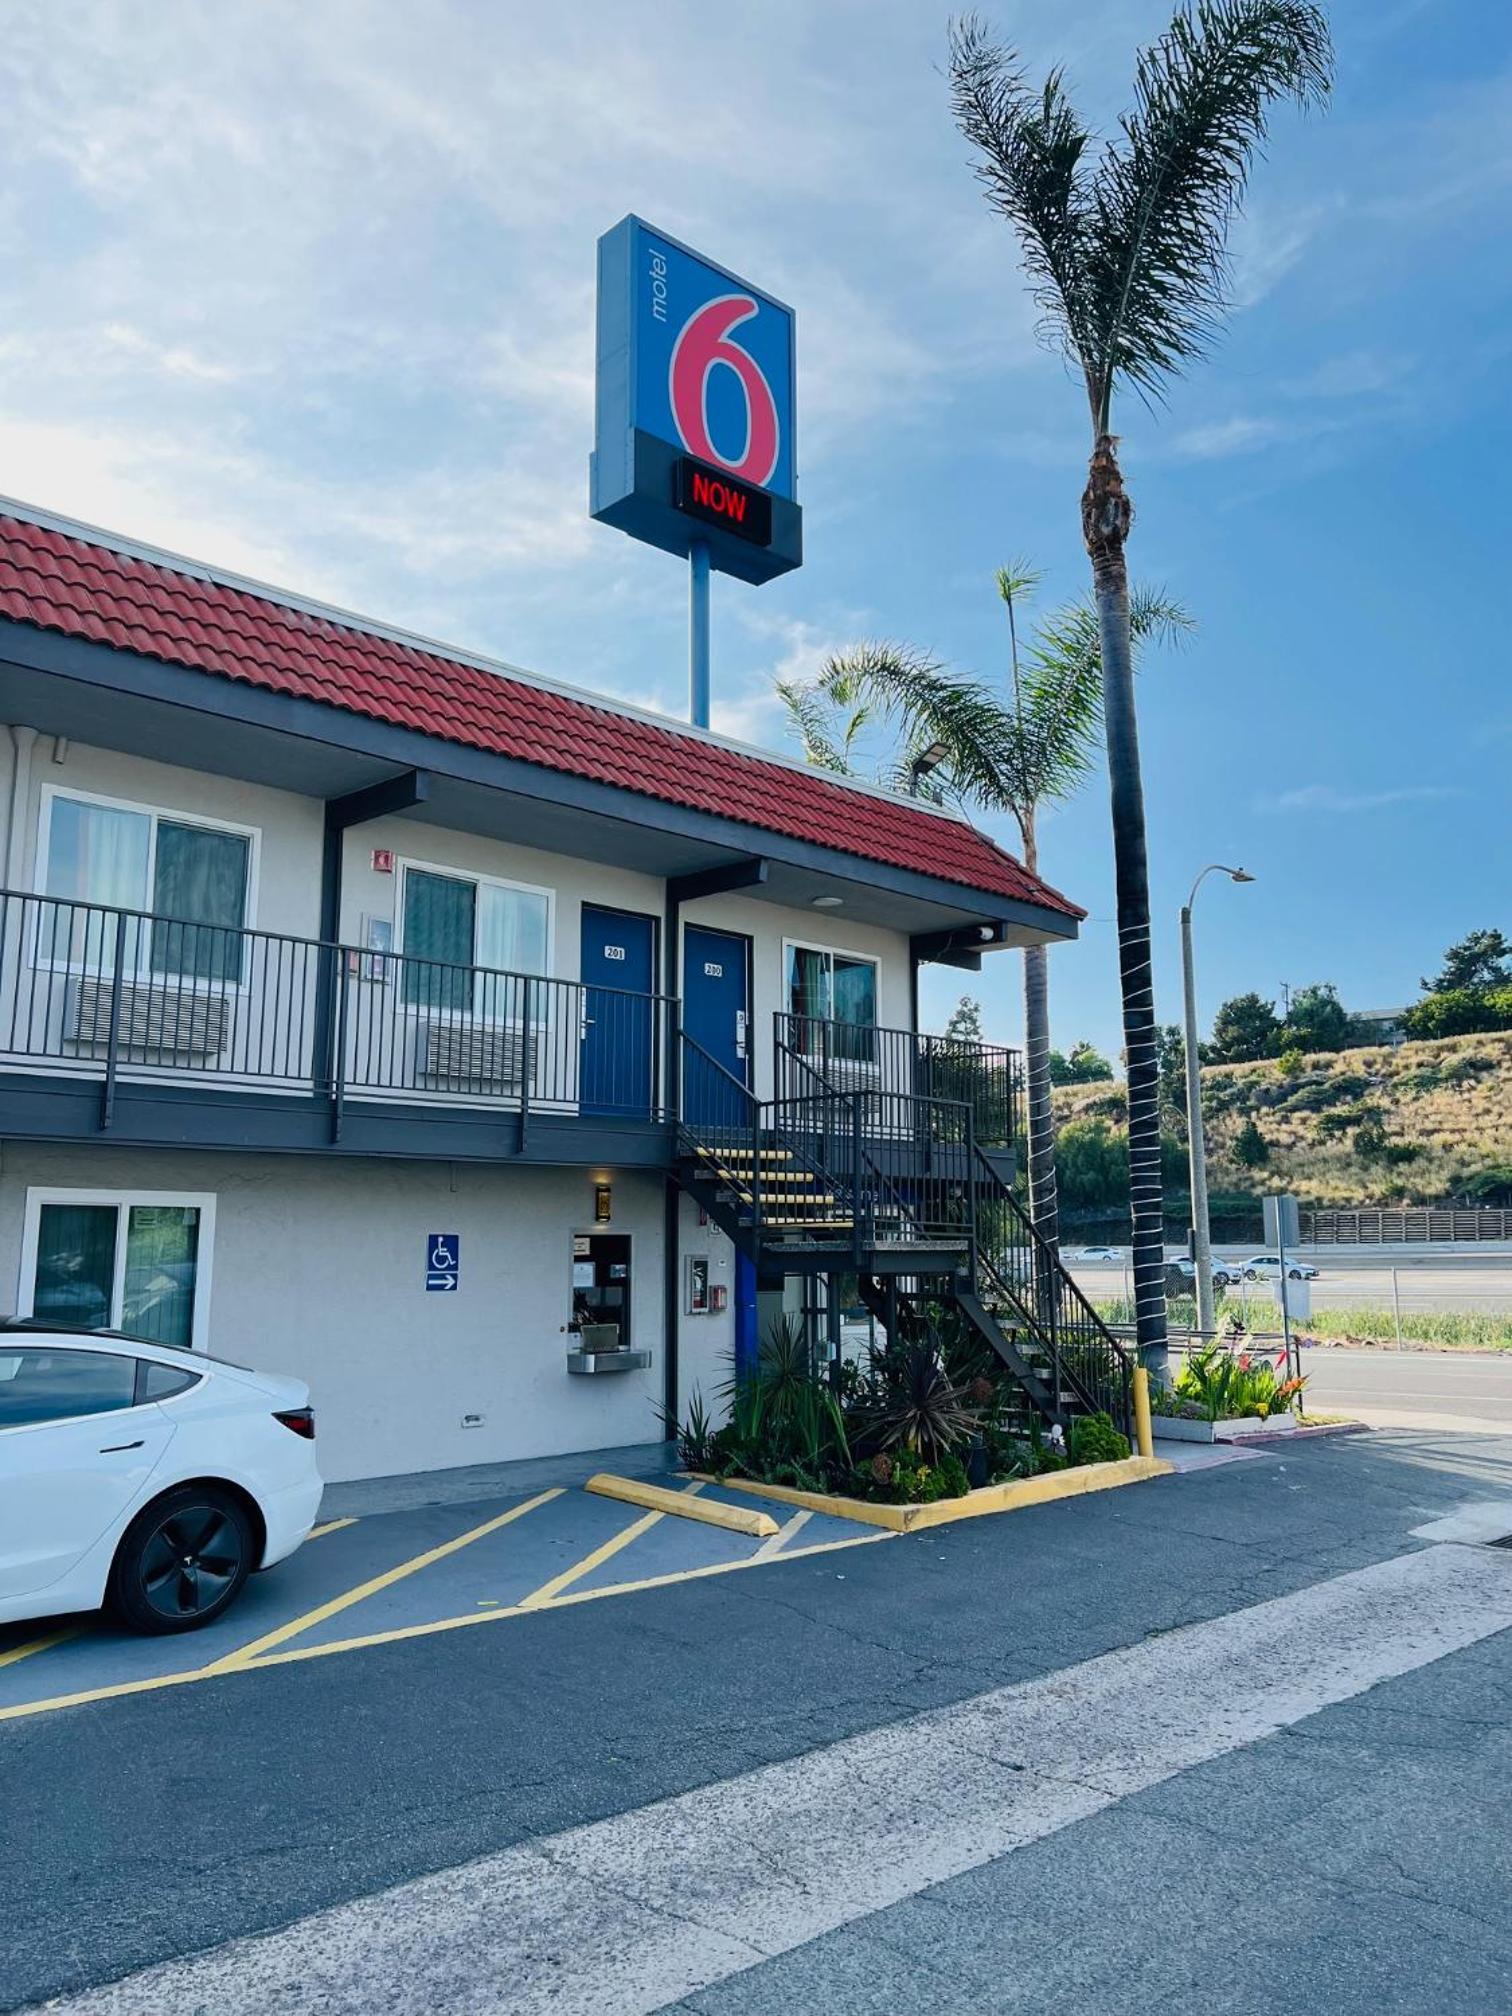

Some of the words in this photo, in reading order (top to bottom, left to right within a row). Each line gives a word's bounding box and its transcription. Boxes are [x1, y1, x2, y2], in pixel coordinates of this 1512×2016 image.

[649, 248, 667, 323] motel
[669, 293, 780, 487] 6
[692, 473, 746, 522] NOW
[607, 947, 623, 960] 201
